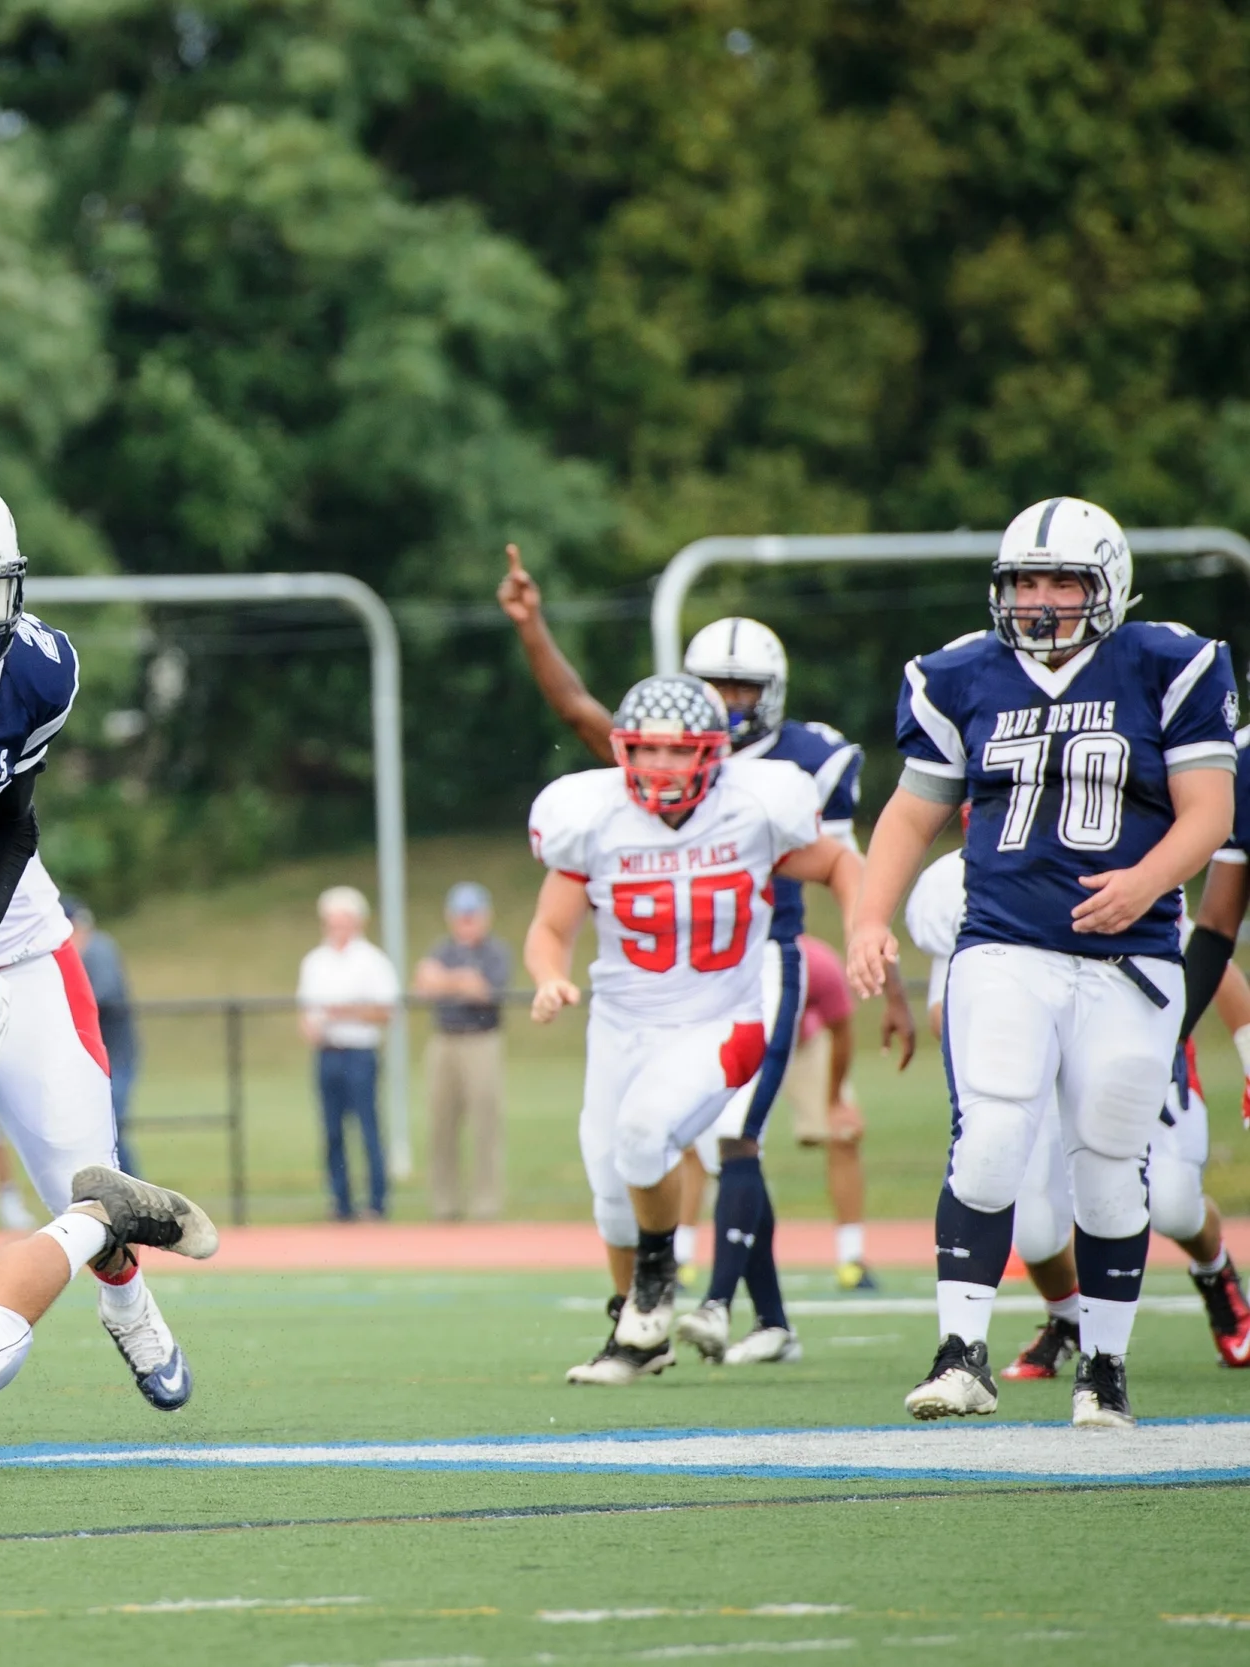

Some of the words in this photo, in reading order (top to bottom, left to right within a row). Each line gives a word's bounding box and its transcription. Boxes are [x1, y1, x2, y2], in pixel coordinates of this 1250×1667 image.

[990, 706, 1042, 741] BLUE
[1044, 701, 1116, 734] DEVILS
[981, 731, 1131, 853] 70
[619, 851, 681, 875] MILLER
[687, 841, 740, 872] PLACE
[612, 869, 754, 974] 90
